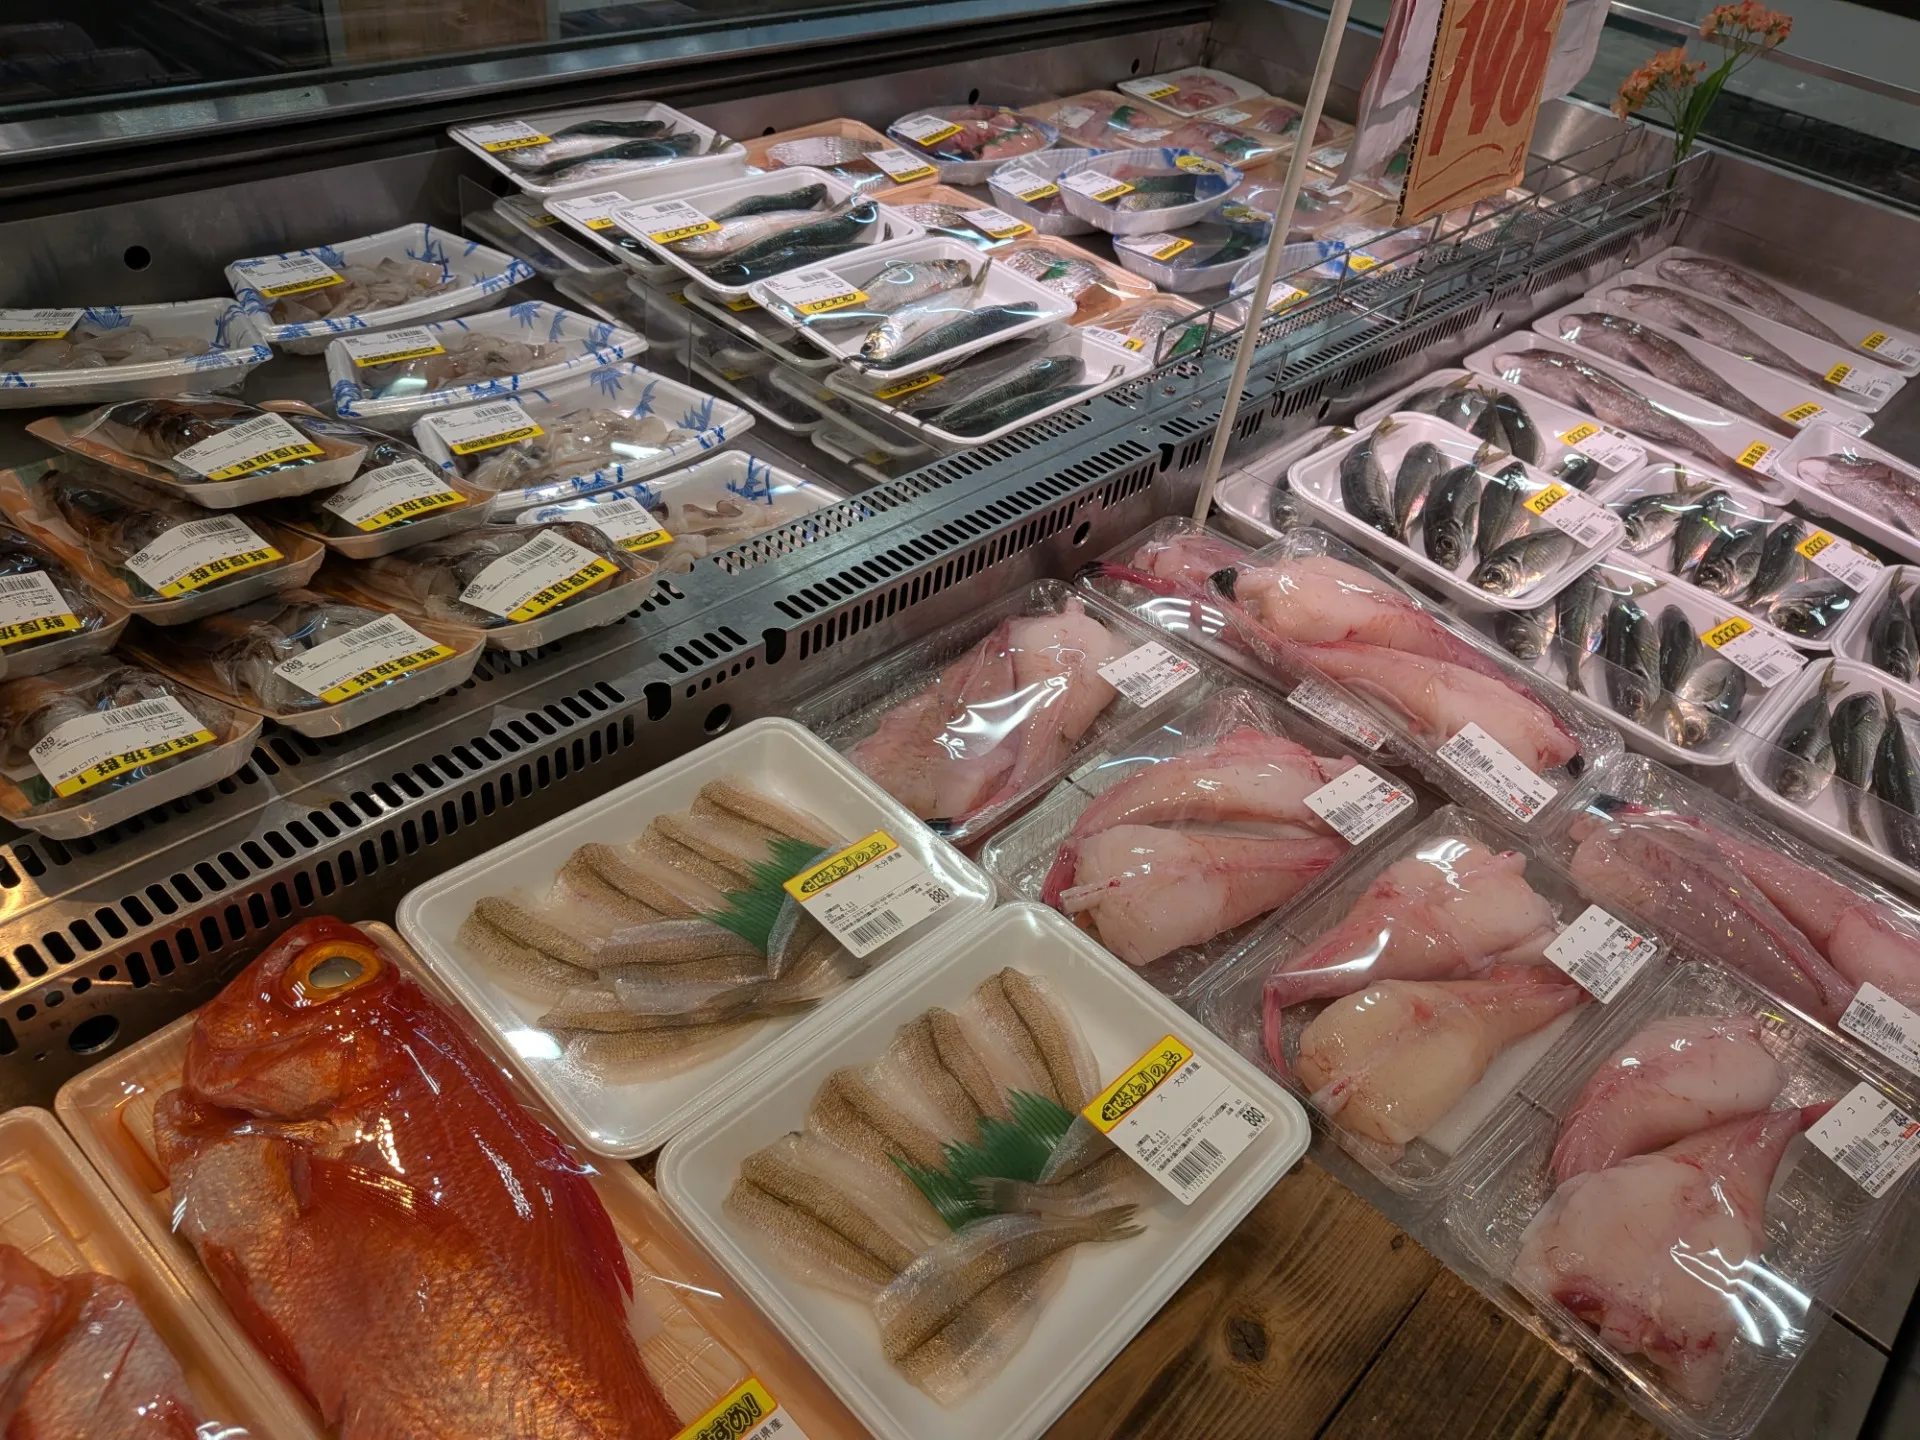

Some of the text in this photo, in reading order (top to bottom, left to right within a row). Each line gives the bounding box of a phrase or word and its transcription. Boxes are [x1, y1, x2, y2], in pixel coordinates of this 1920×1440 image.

[928, 888, 950, 904] 880
[1173, 1062, 1202, 1087] 大分県産
[1242, 1106, 1265, 1127] 880
